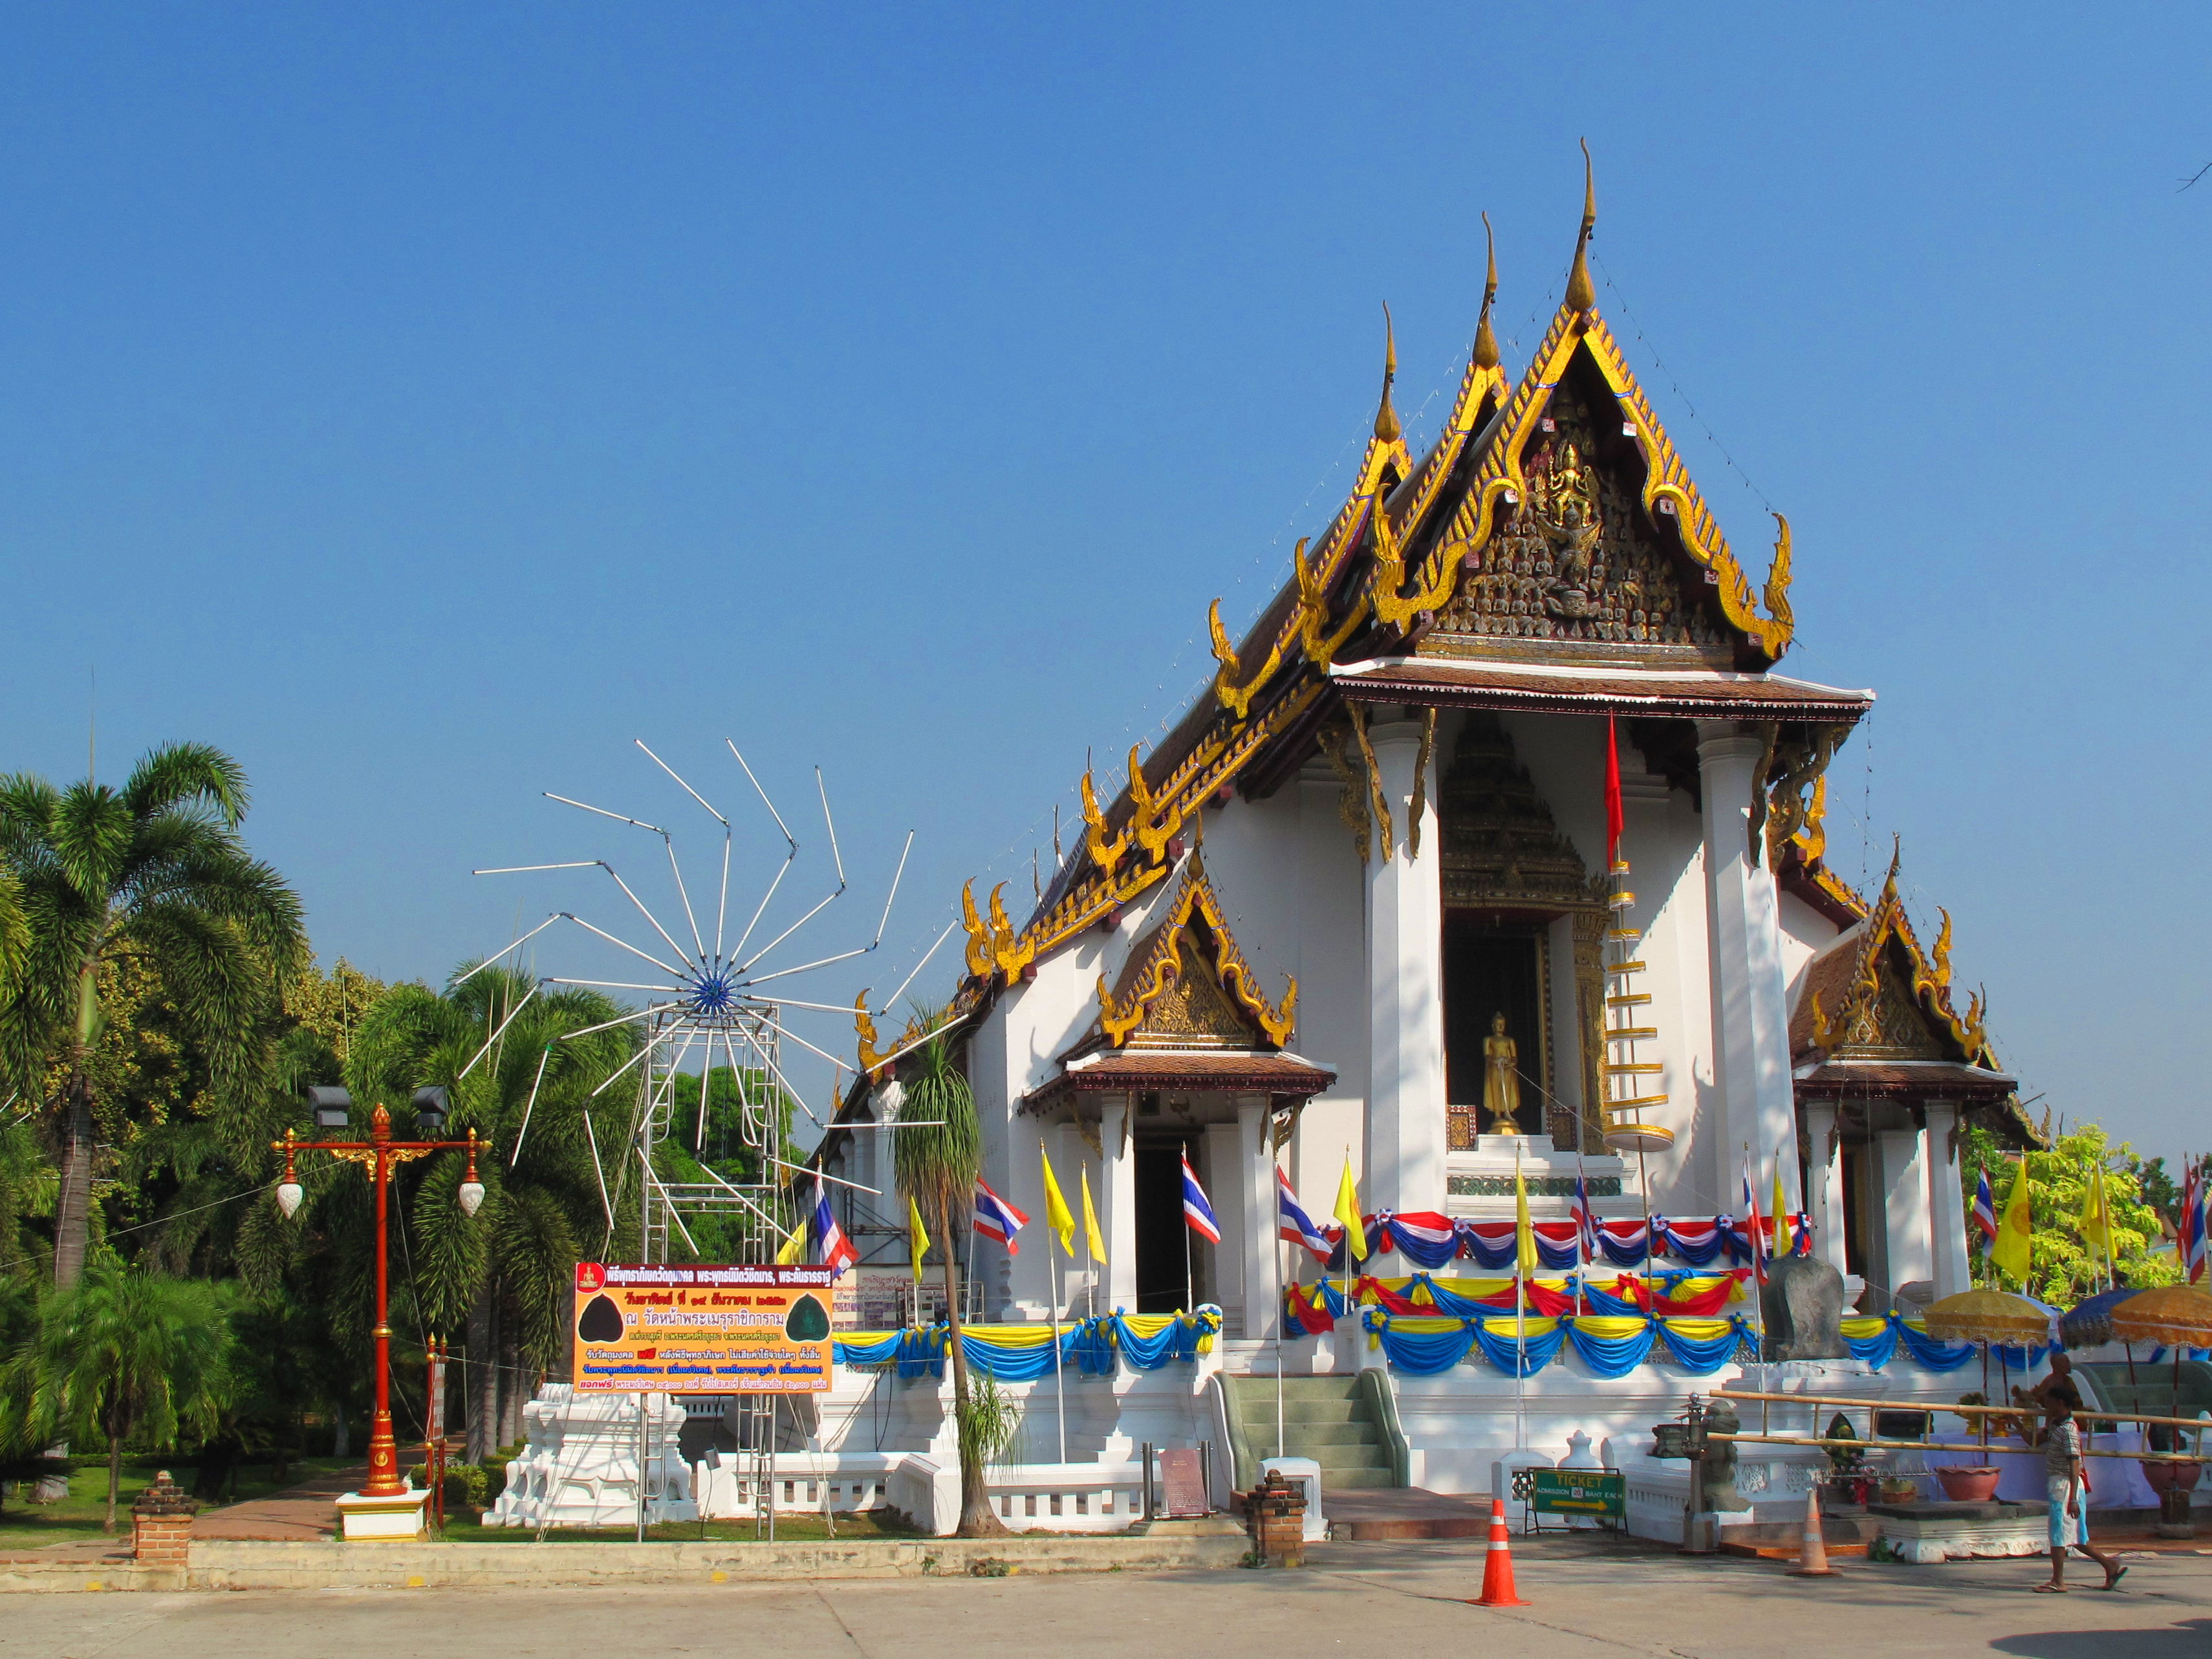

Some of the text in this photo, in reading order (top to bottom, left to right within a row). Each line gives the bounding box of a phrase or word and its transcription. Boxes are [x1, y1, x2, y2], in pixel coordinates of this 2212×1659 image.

[625, 1292, 673, 1305] วันอาทิตย์
[711, 1292, 751, 1305] ธันวาคม
[625, 1307, 785, 1330] ณ วัดหน้าพระเมรุราชิการาม
[586, 1349, 634, 1361] รับวัตถุมงคล
[637, 1348, 656, 1360] ฟรี
[799, 1347, 821, 1360] ทั้งสิ้น
[580, 1379, 614, 1389] แจกฟรี
[812, 1378, 828, 1389] แผ่น
[1556, 1475, 1603, 1488] TICKET
